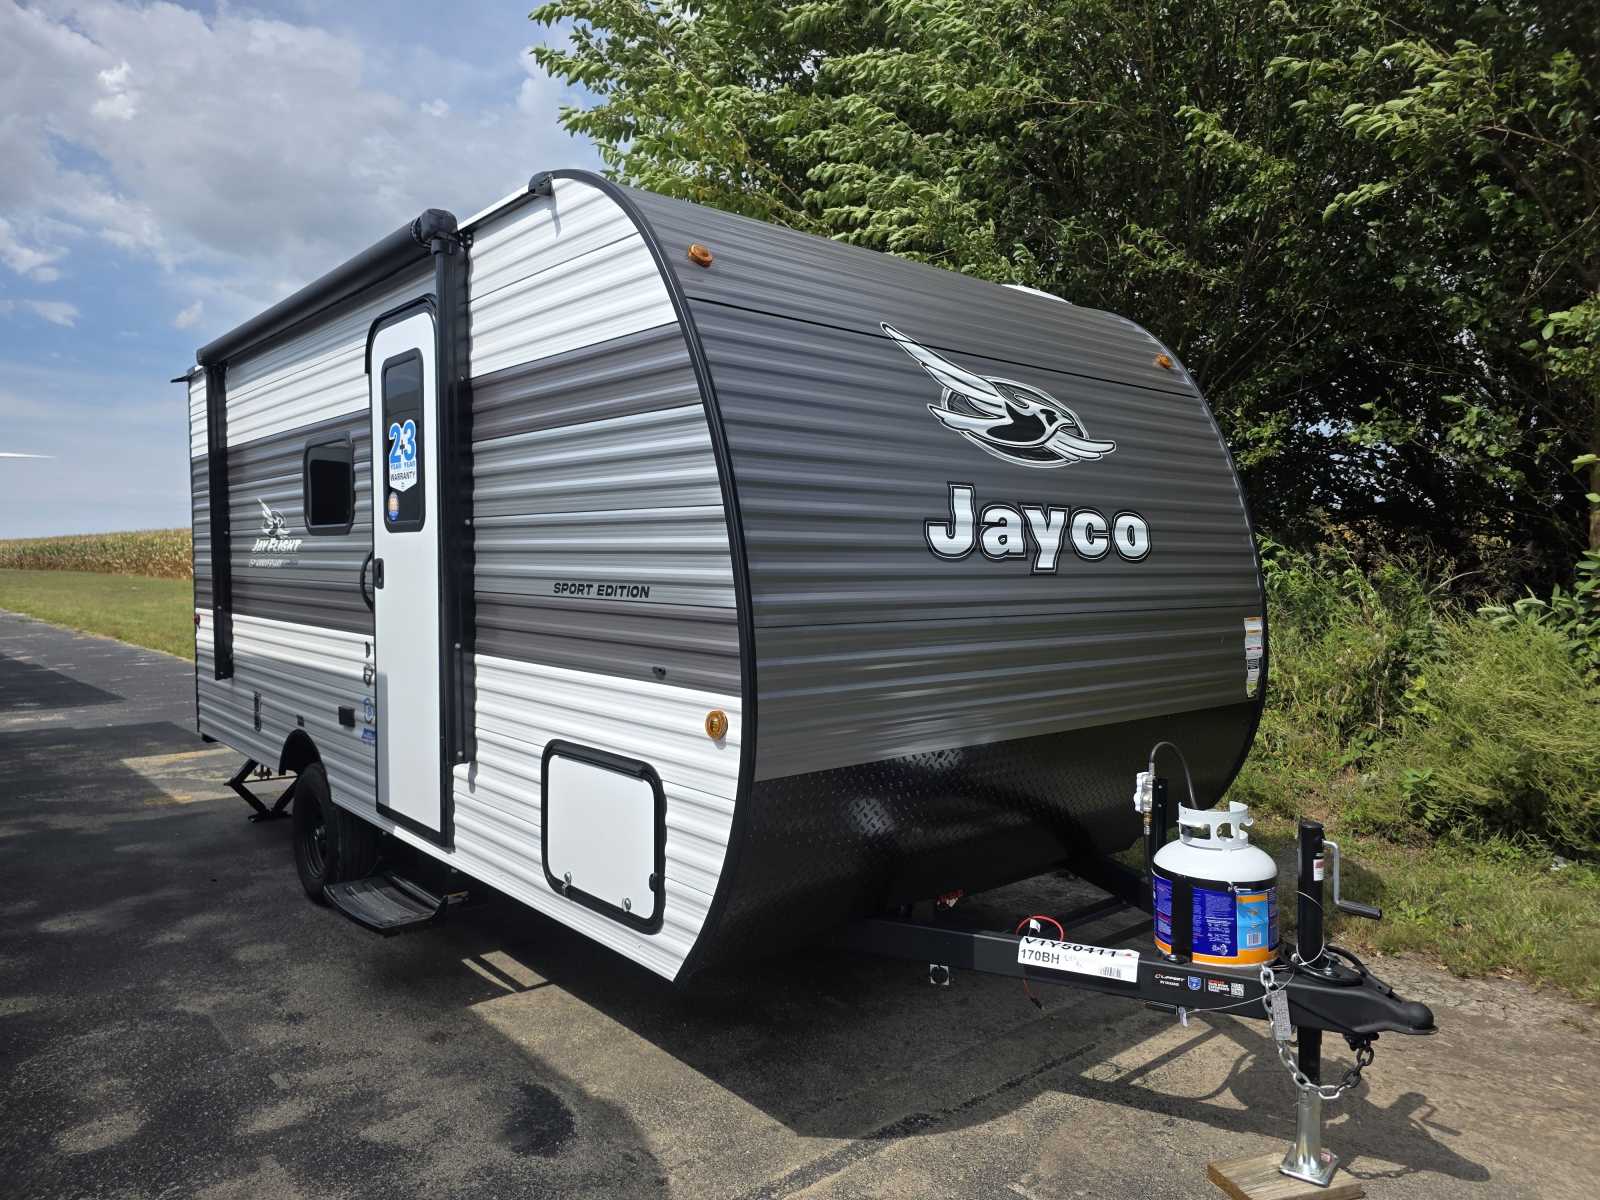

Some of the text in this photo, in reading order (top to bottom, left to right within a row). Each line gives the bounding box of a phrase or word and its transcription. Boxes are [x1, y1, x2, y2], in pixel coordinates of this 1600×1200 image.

[390, 471, 416, 481] WARRANTY
[924, 480, 1152, 576] Jayco
[553, 582, 650, 598] SPORT EDITION
[1021, 949, 1060, 964] 170BH
